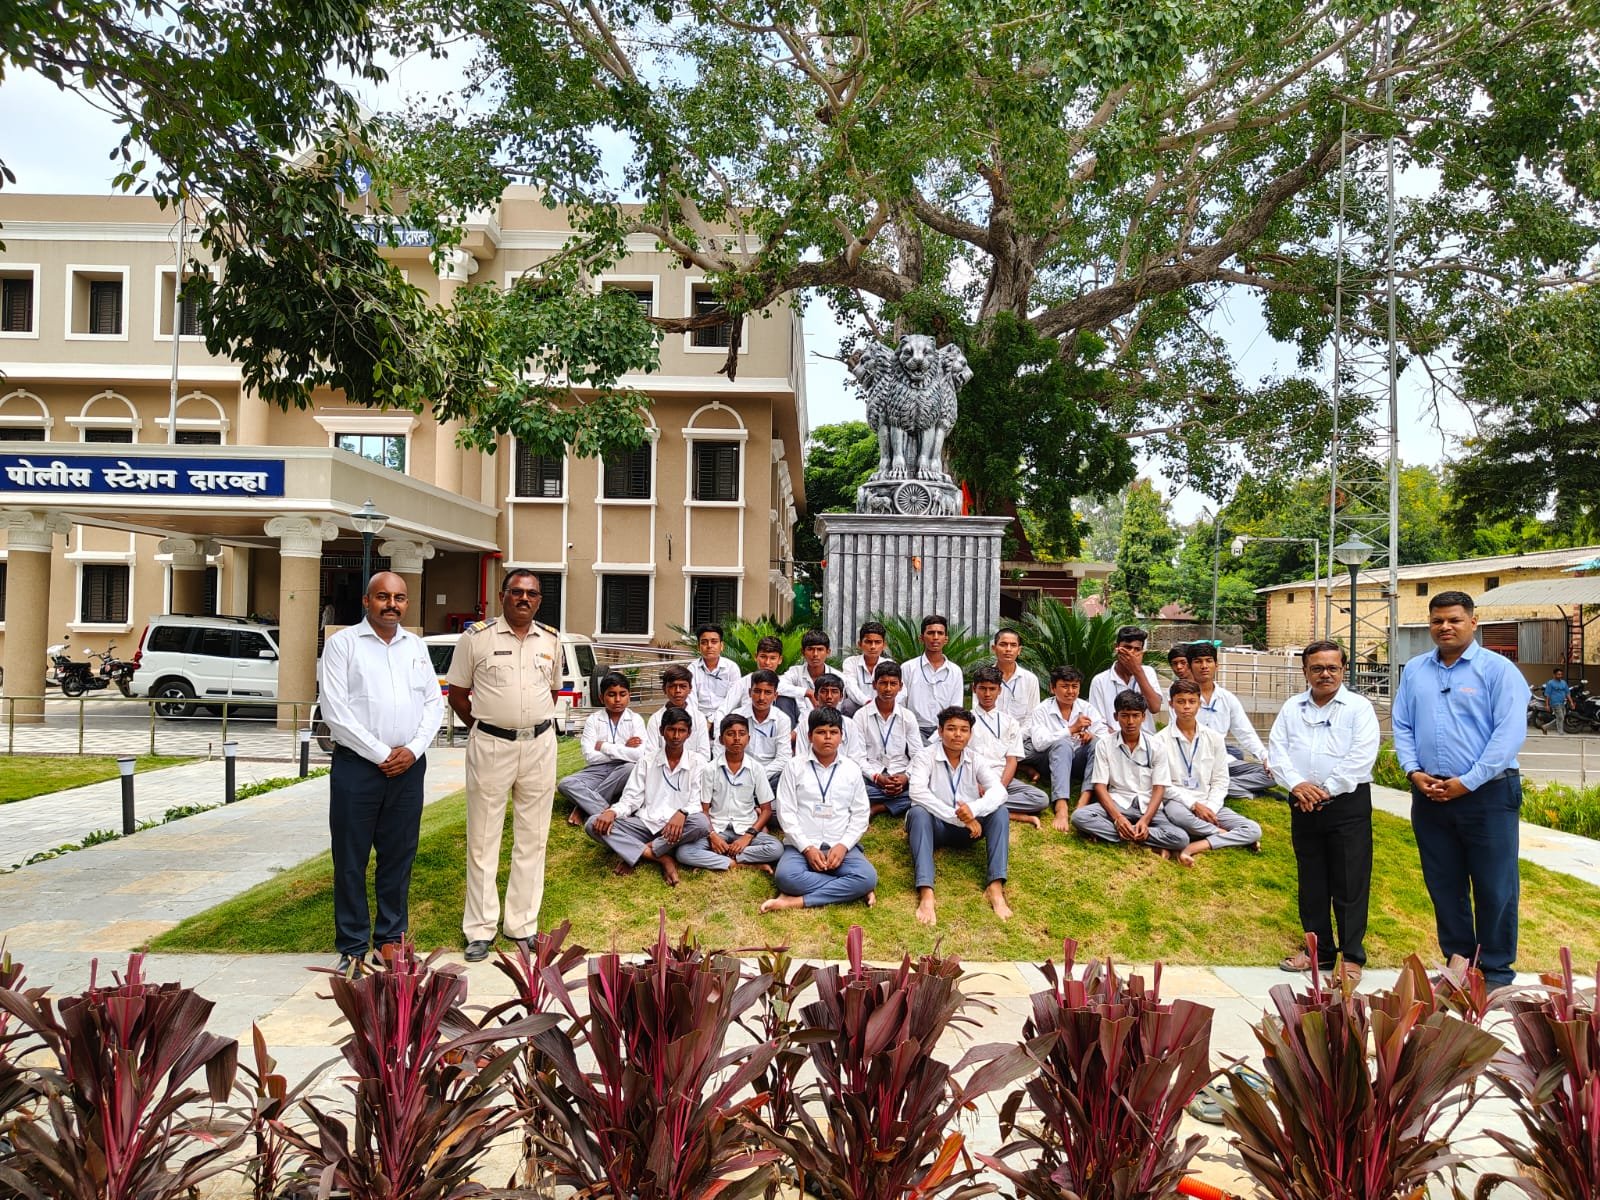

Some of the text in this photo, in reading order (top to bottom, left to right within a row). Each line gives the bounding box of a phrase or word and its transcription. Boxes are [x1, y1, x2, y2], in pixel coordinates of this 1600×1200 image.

[5, 458, 269, 492] पोलीस स्टेशन दारव्हा
